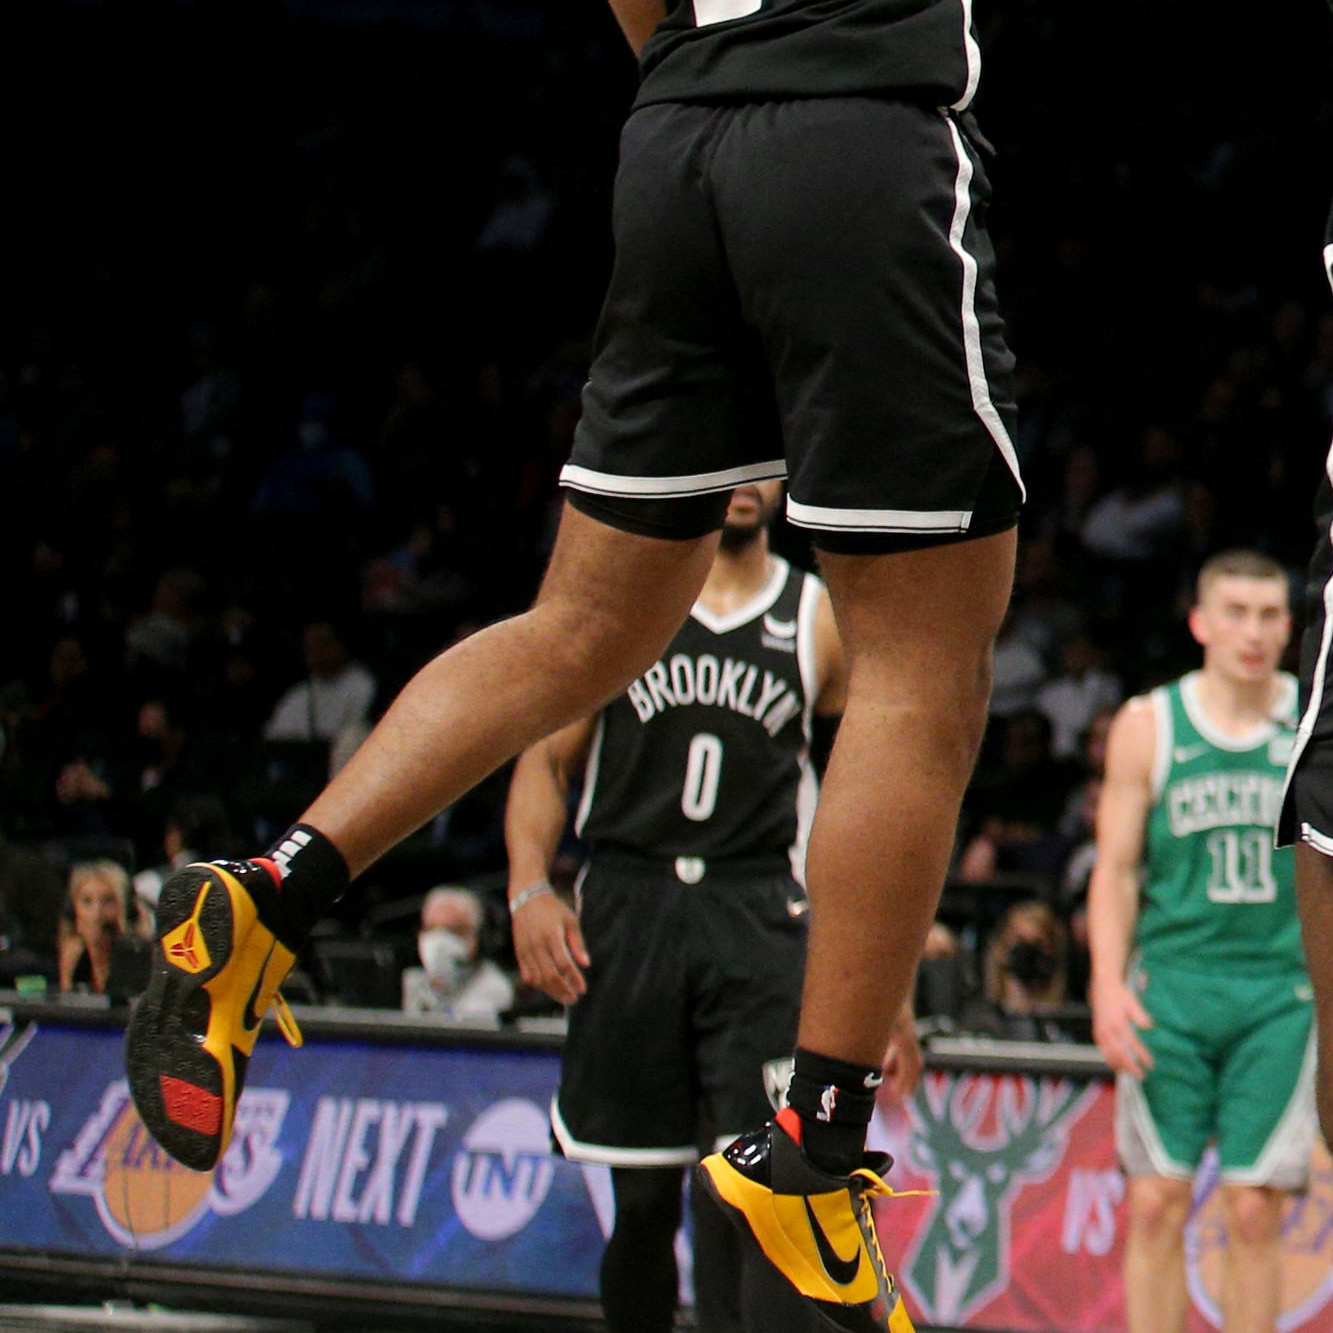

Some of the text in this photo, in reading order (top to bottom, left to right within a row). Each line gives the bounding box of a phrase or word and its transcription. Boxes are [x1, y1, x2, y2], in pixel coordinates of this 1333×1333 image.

[627, 653, 800, 738] BROOKLYN
[681, 732, 723, 822] 0
[1206, 830, 1278, 904] 11
[0, 1098, 51, 1178] VS
[292, 1095, 449, 1228] NEXT
